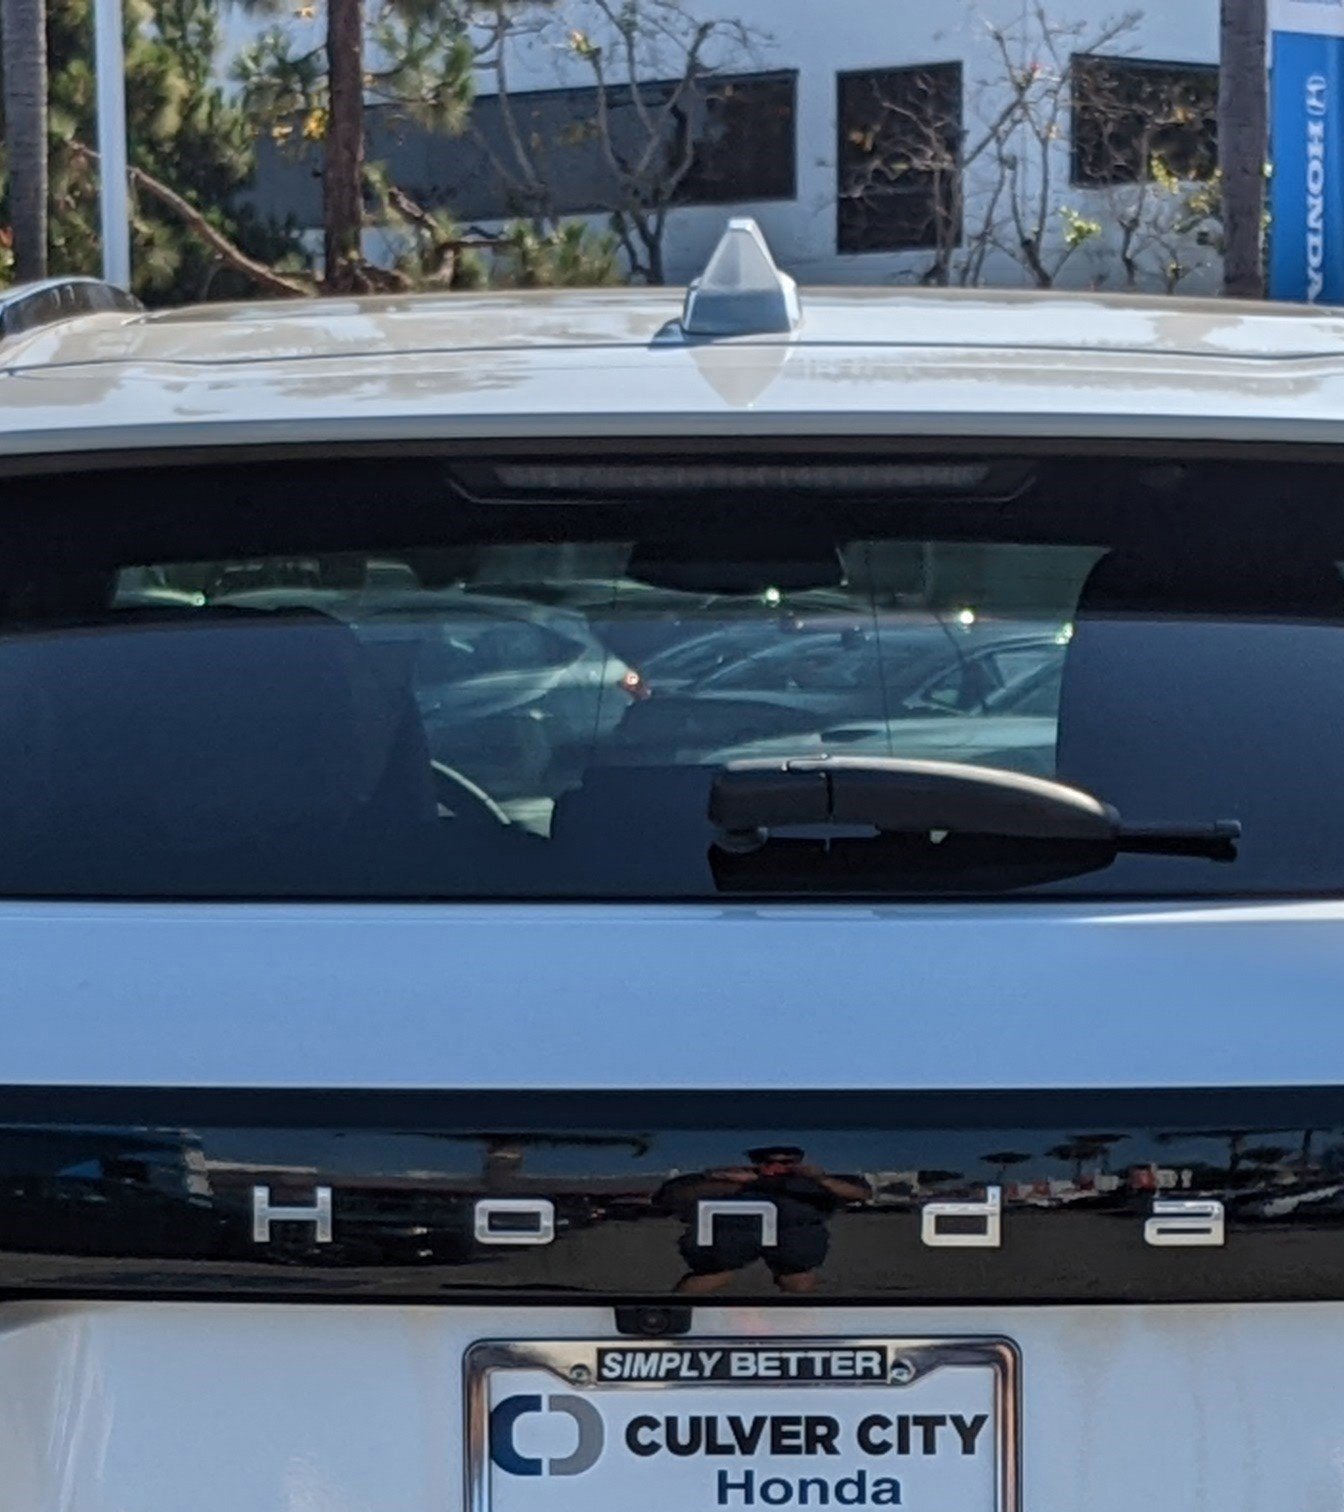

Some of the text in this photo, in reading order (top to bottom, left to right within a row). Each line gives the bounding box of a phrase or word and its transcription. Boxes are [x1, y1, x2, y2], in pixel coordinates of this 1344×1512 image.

[1306, 120, 1325, 304] HONDA
[601, 1351, 883, 1378] SIMPLY BETTER
[625, 1414, 989, 1457] CULVER CITY
[717, 1469, 902, 1506] Honda
